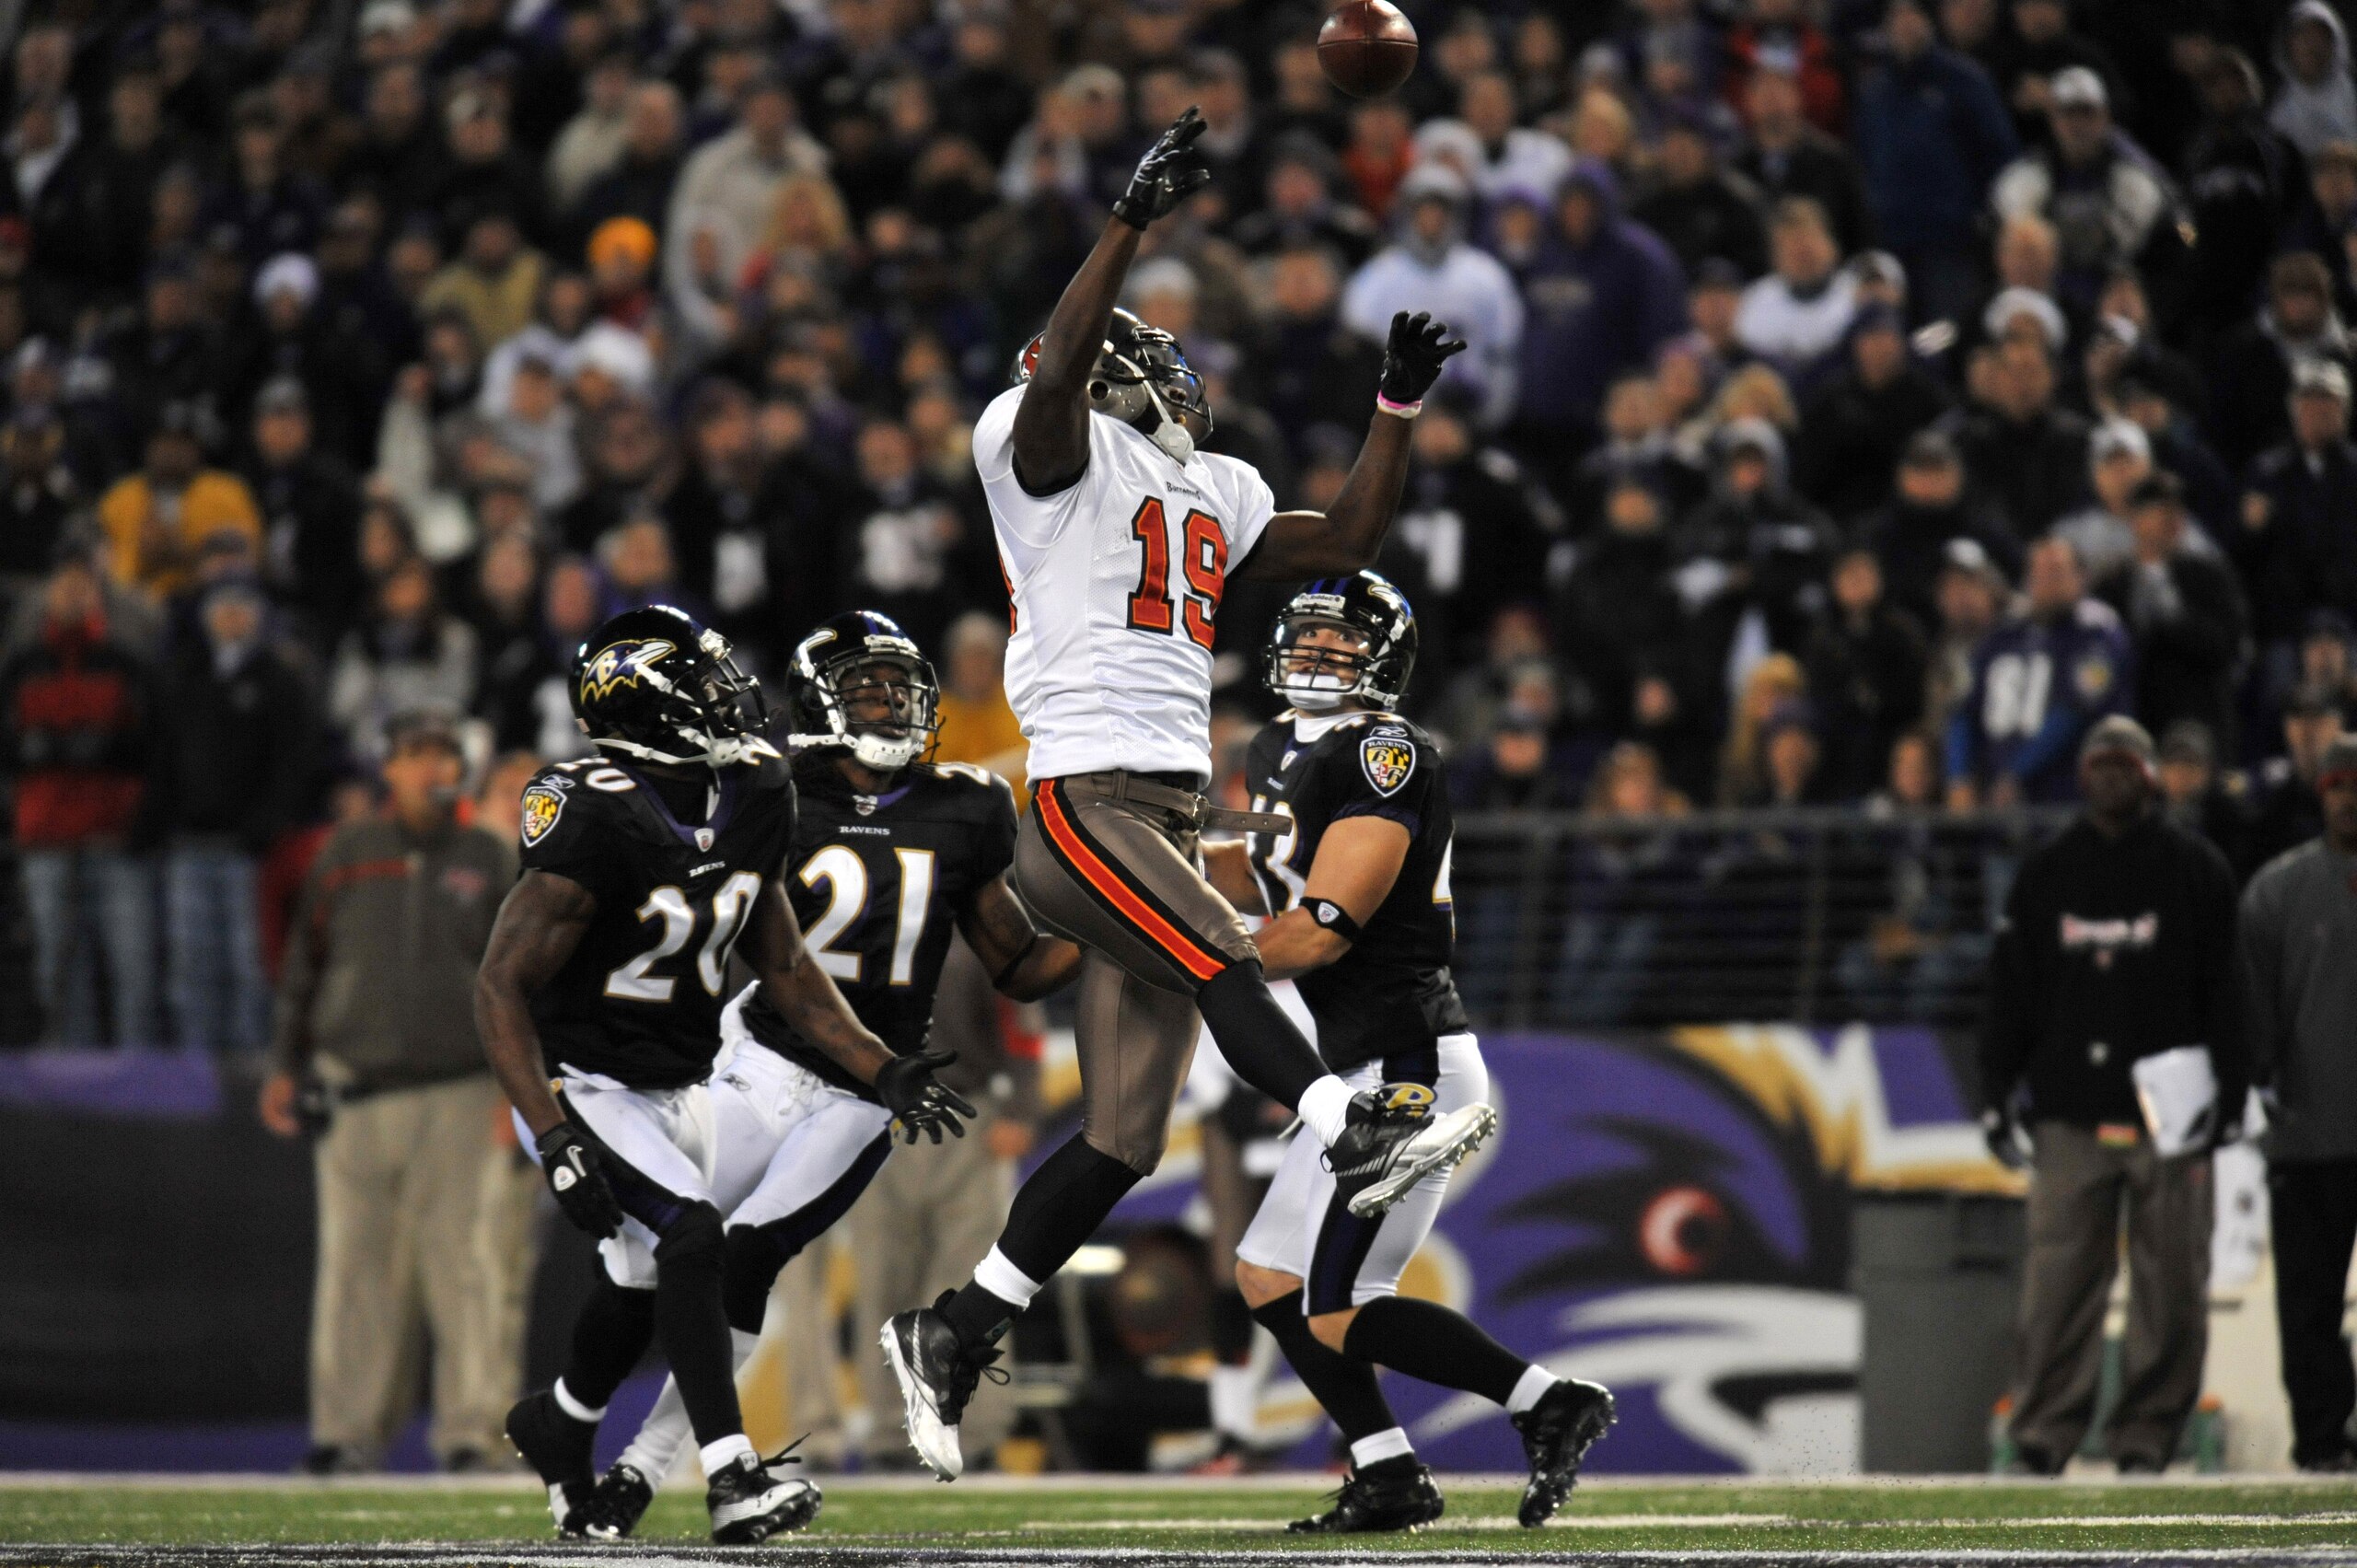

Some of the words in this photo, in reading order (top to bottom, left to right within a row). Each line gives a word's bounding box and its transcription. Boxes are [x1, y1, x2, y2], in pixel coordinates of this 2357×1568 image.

[1126, 495, 1229, 651] 19
[1367, 740, 1409, 751] RAVENS
[839, 826, 890, 836] RAVENS
[603, 871, 762, 1003] 20
[798, 844, 935, 985] 21
